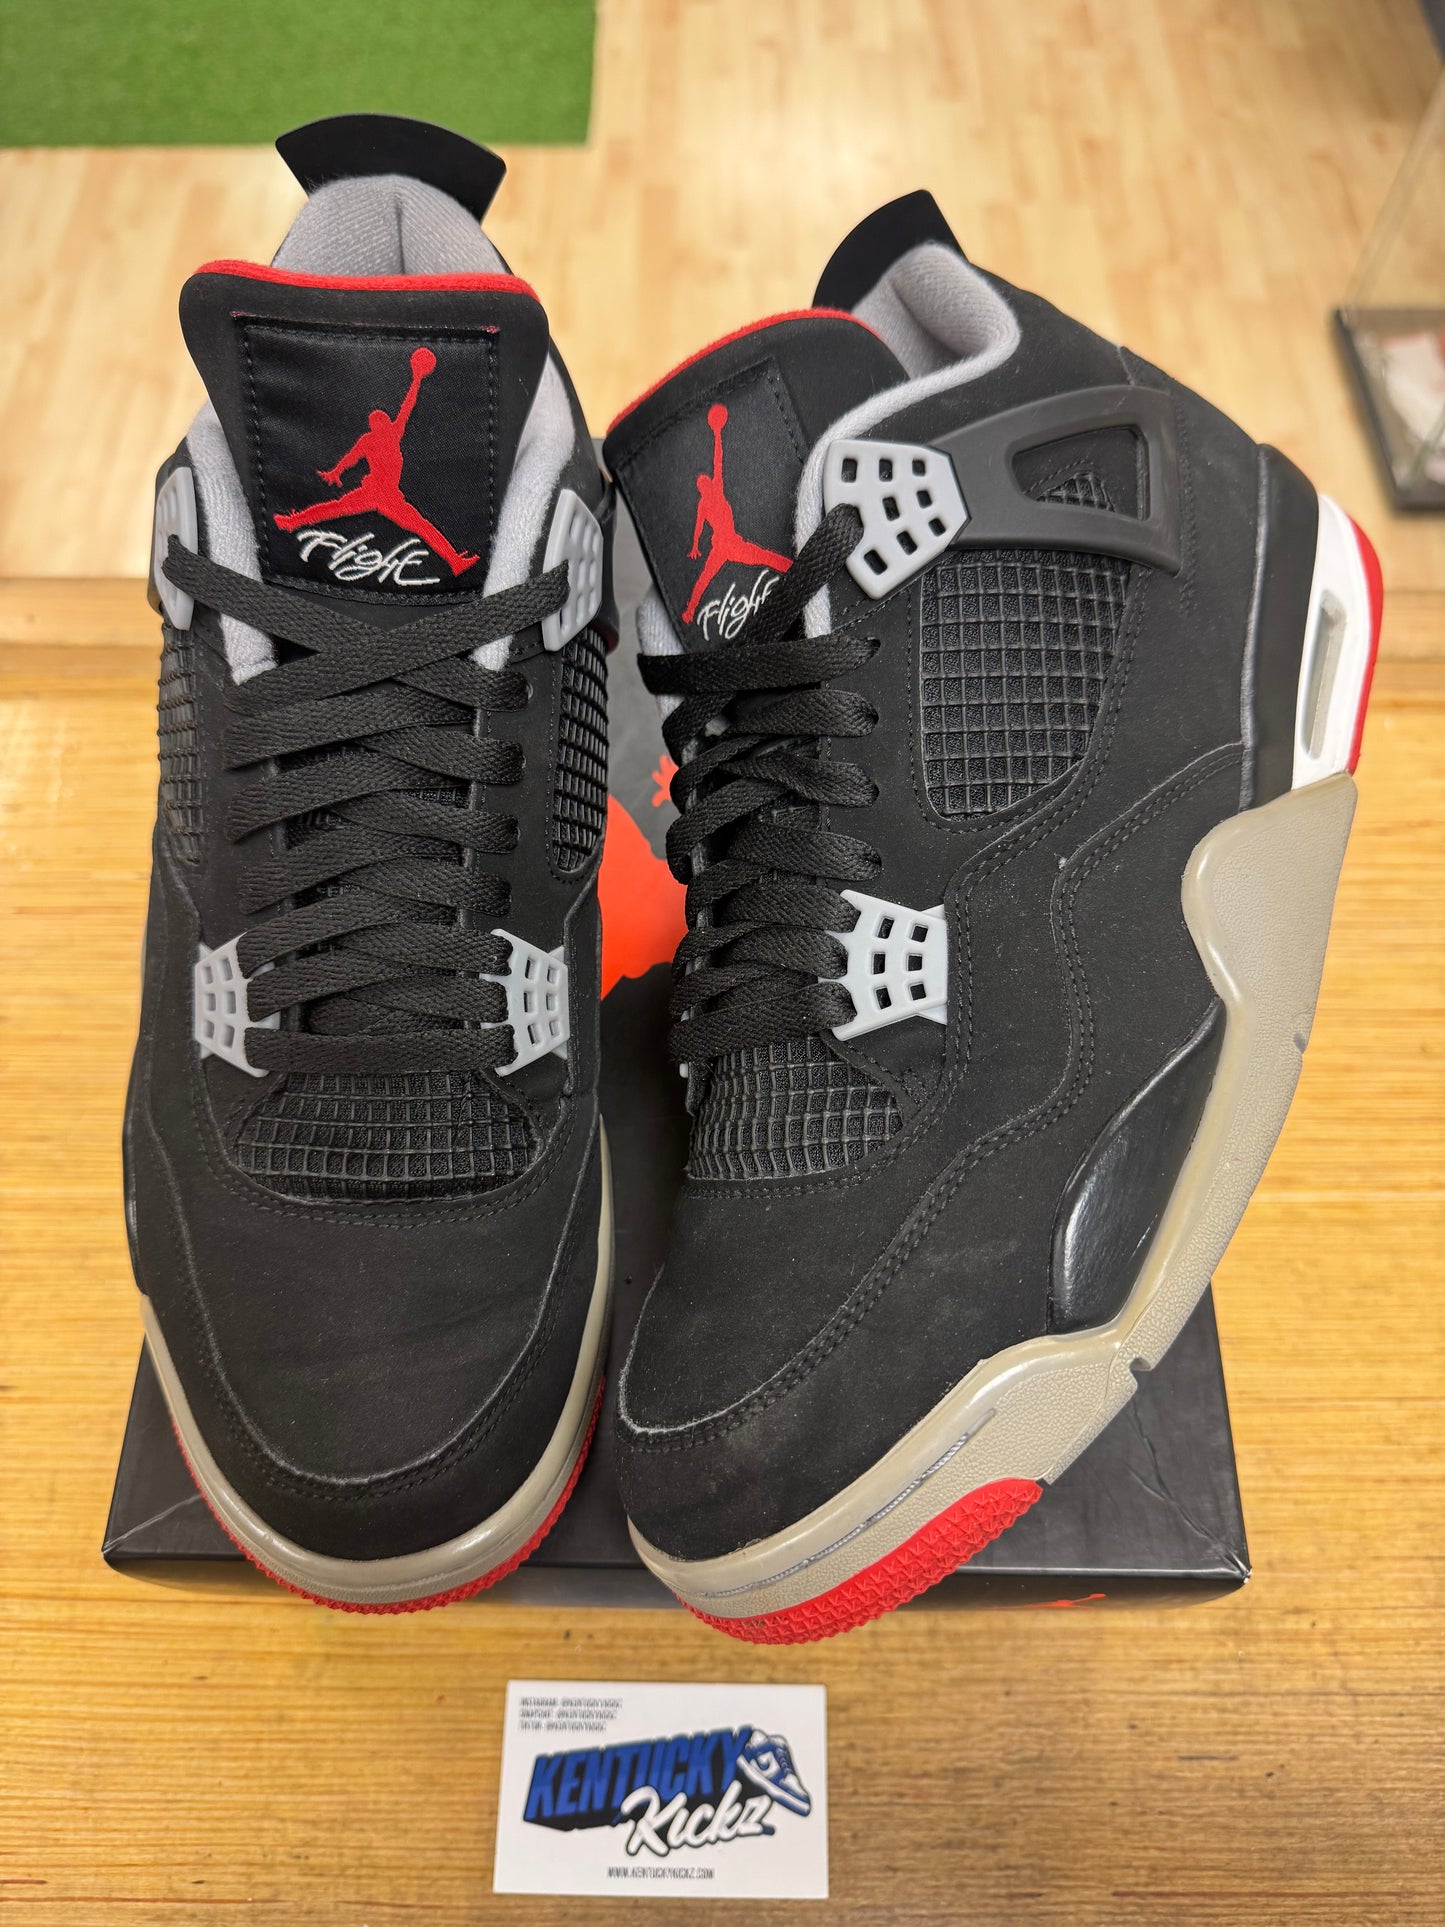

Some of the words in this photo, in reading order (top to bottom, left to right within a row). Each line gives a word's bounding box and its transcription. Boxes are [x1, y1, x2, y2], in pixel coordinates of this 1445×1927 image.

[296, 528, 441, 586] Flight
[523, 1725, 755, 1823] KENTUCKY
[620, 1780, 773, 1857] Kickz
